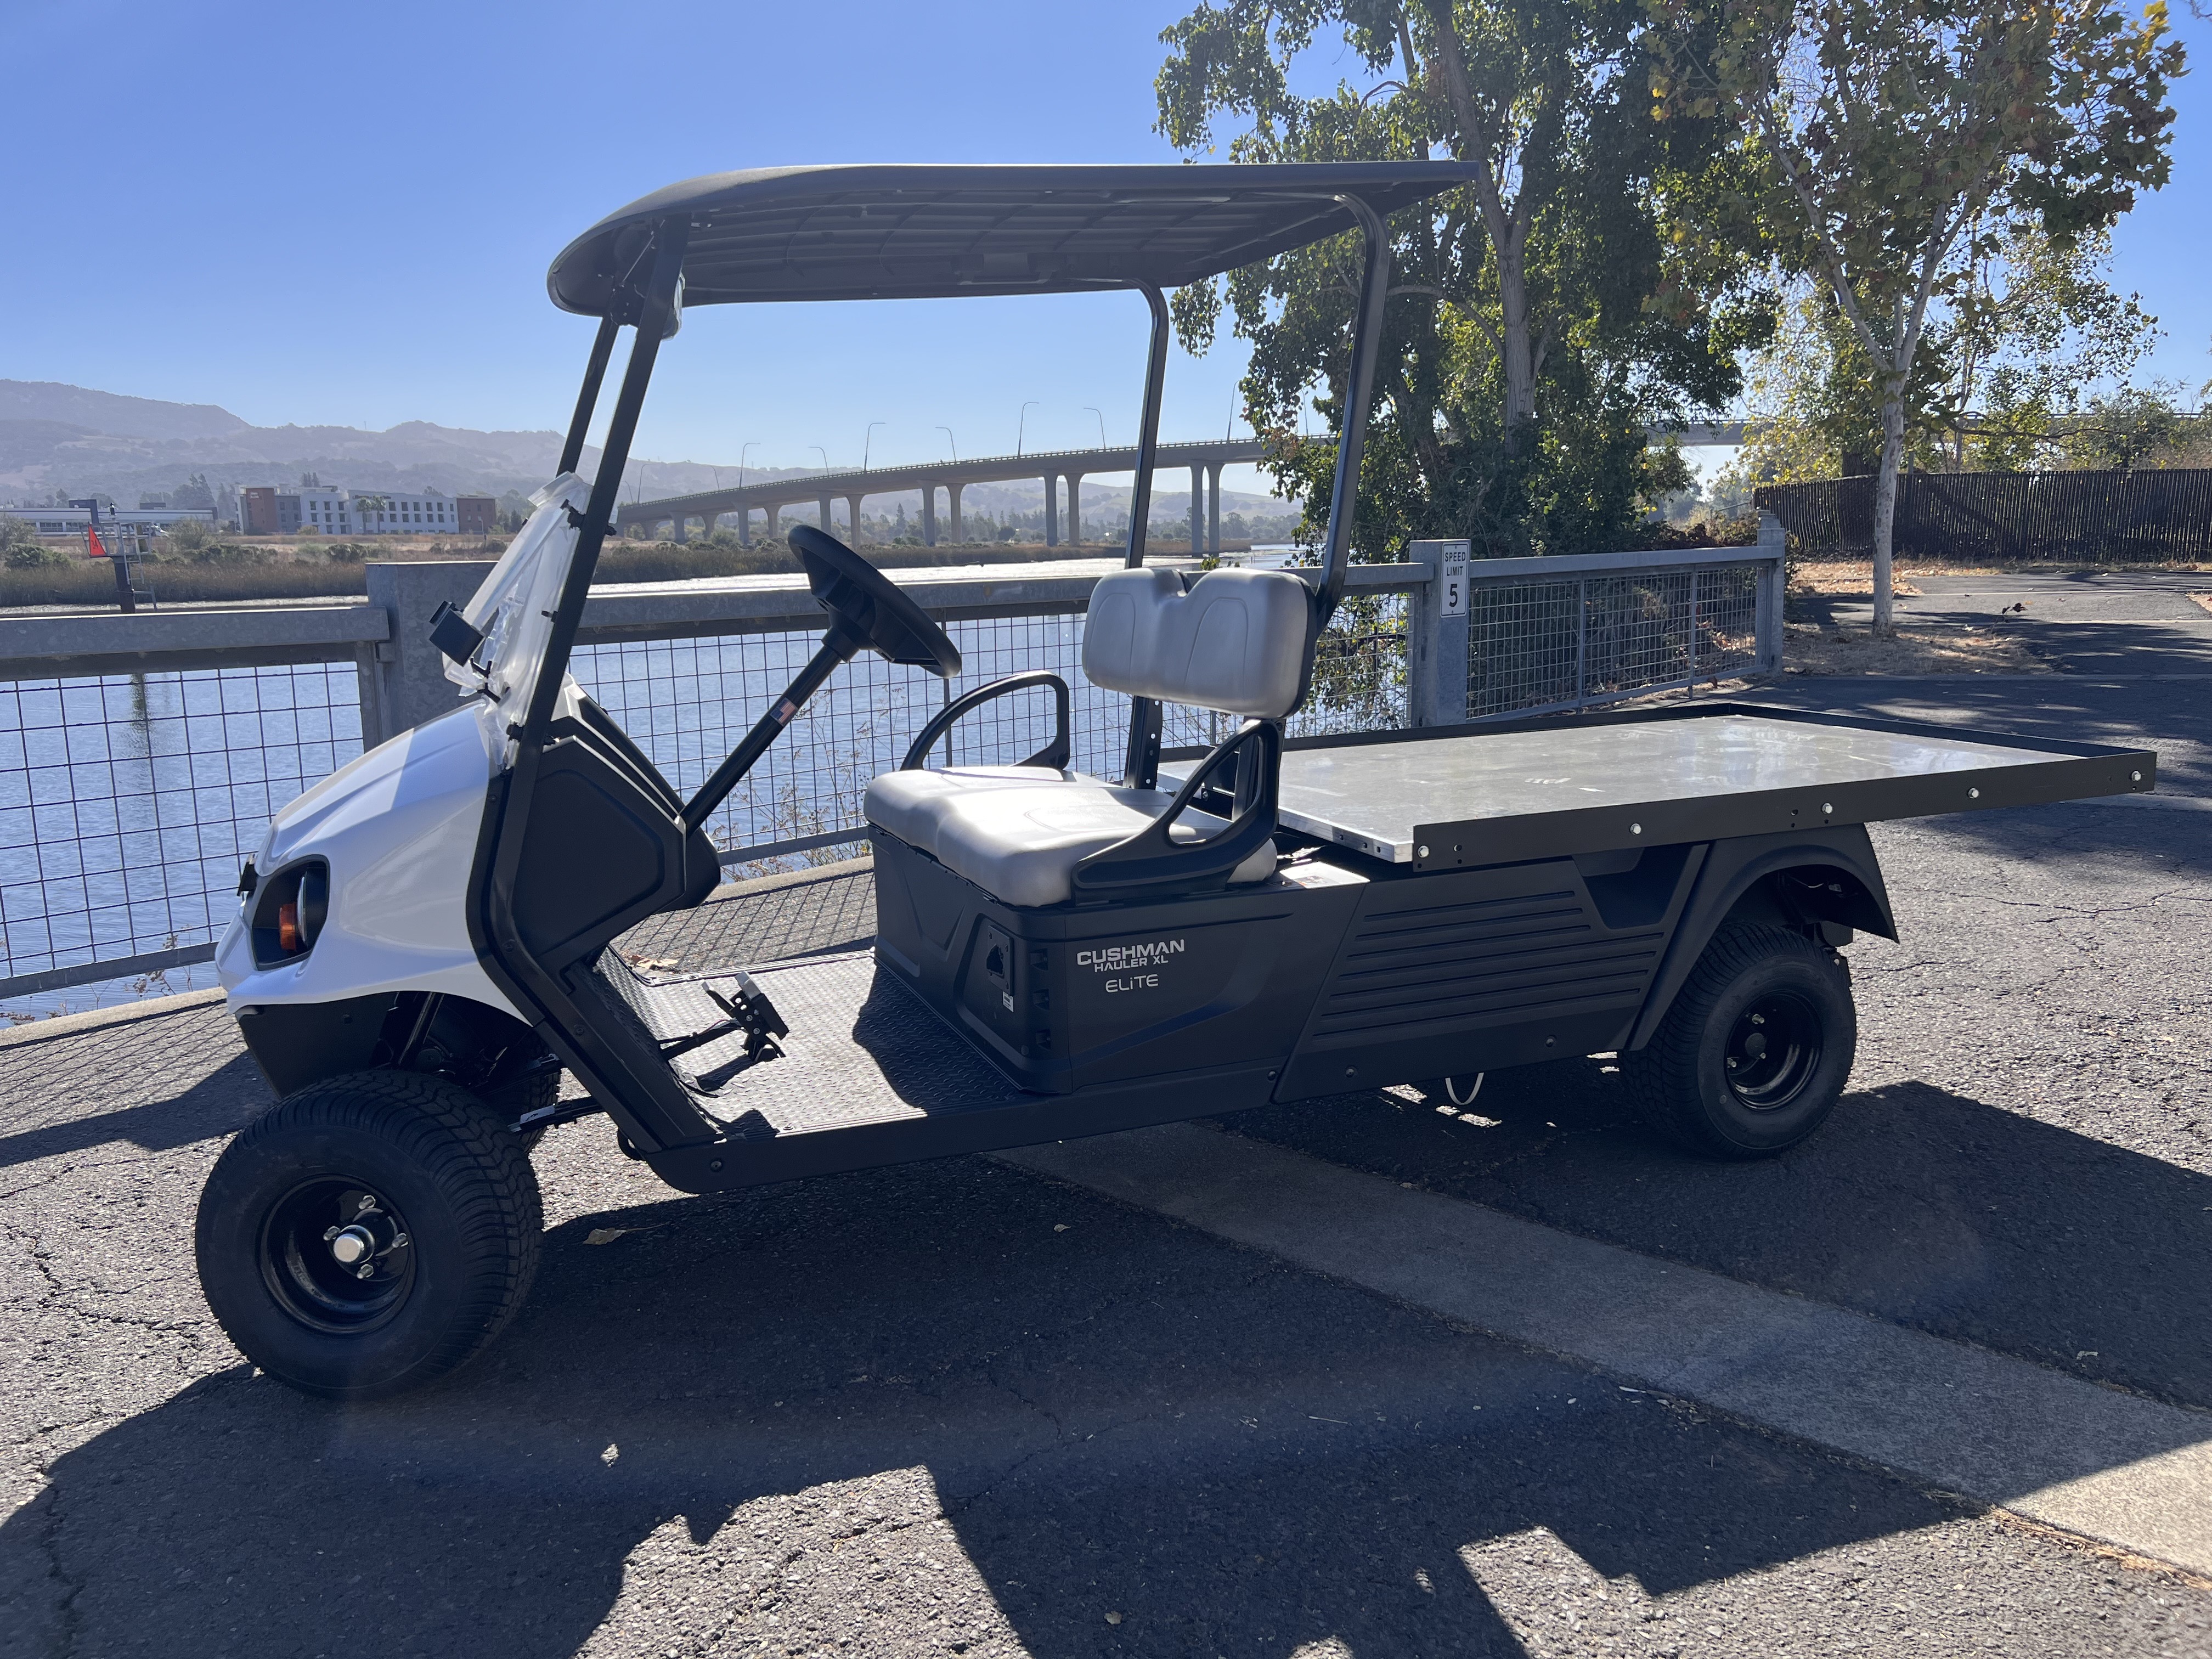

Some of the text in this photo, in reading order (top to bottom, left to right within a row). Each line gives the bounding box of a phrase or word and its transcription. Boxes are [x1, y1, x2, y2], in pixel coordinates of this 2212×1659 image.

[1444, 552, 1466, 562] SPEED
[1446, 566, 1463, 576] LIMIT
[1449, 583, 1458, 607] 5
[1076, 939, 1184, 966] CUSHMAN
[1094, 955, 1169, 973] HAULER XL
